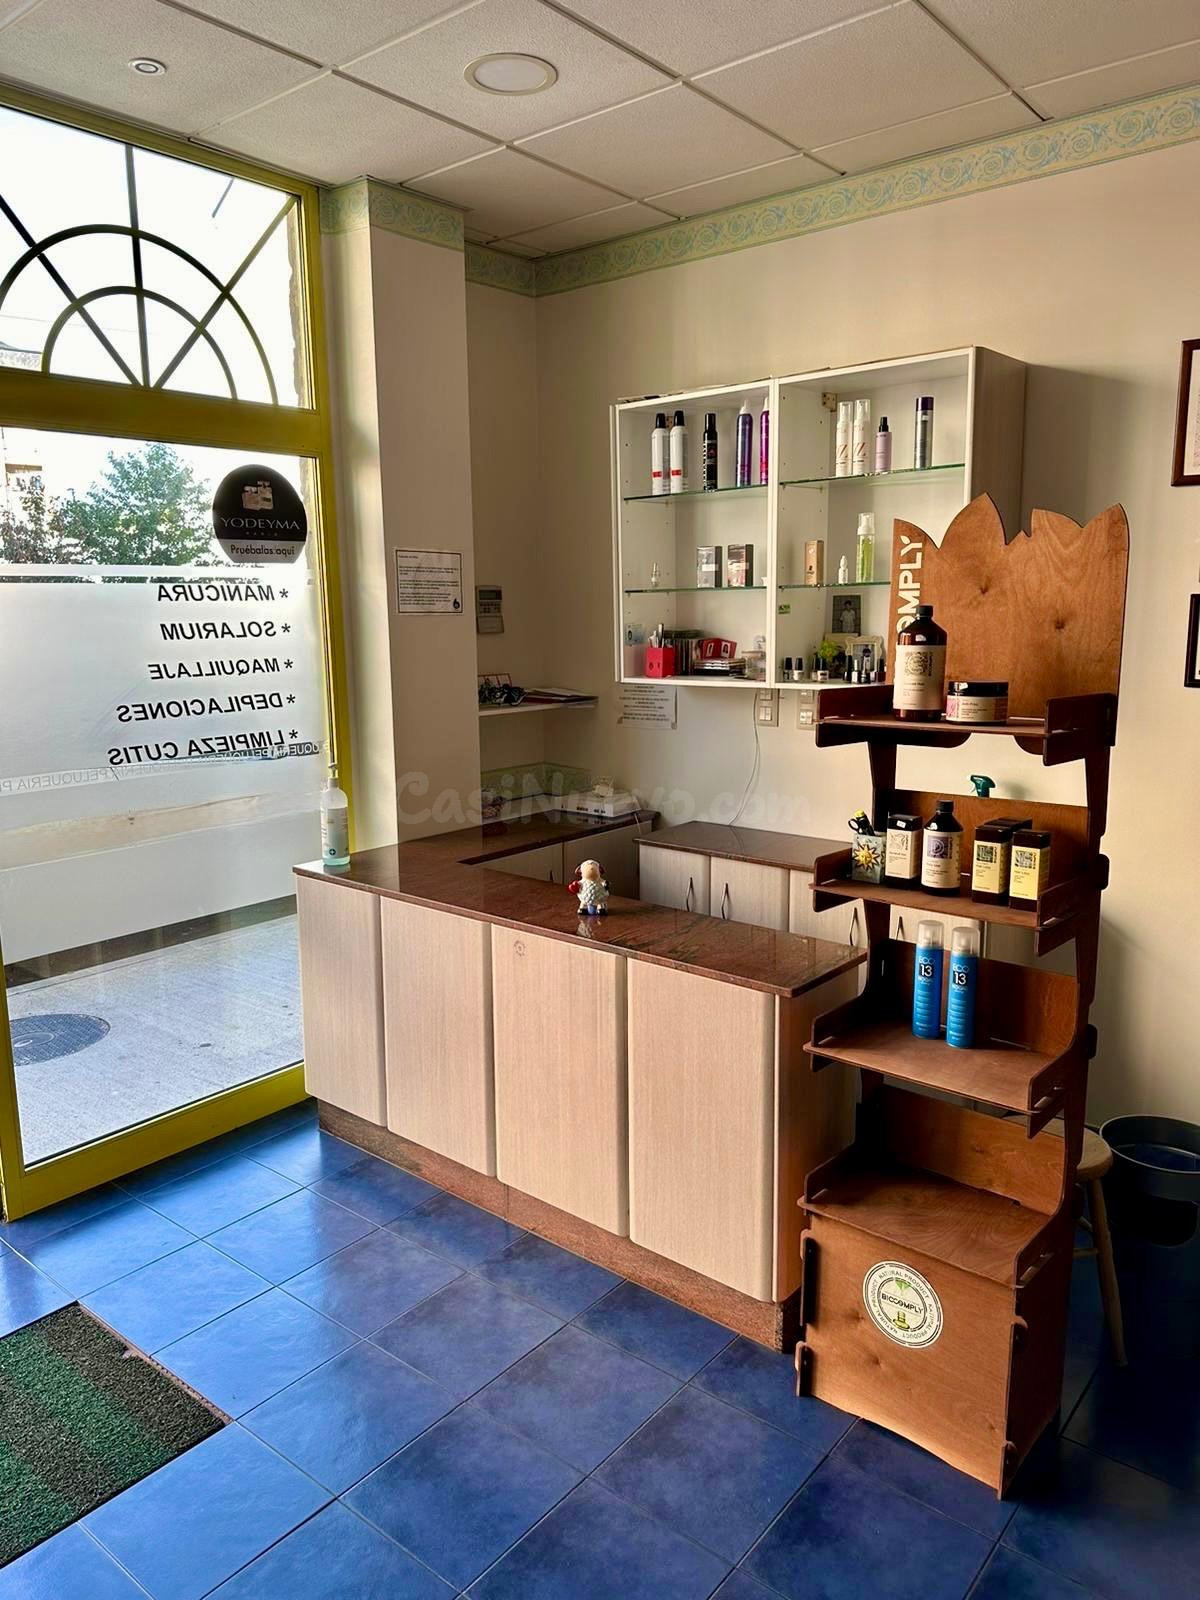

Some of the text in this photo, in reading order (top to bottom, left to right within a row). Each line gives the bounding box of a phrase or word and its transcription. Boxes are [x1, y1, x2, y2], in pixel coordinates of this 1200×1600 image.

[220, 517, 300, 530] YODEYMA
[230, 544, 274, 555] Pruébalas
[920, 964, 933, 977] 13
[954, 971, 967, 985] 13
